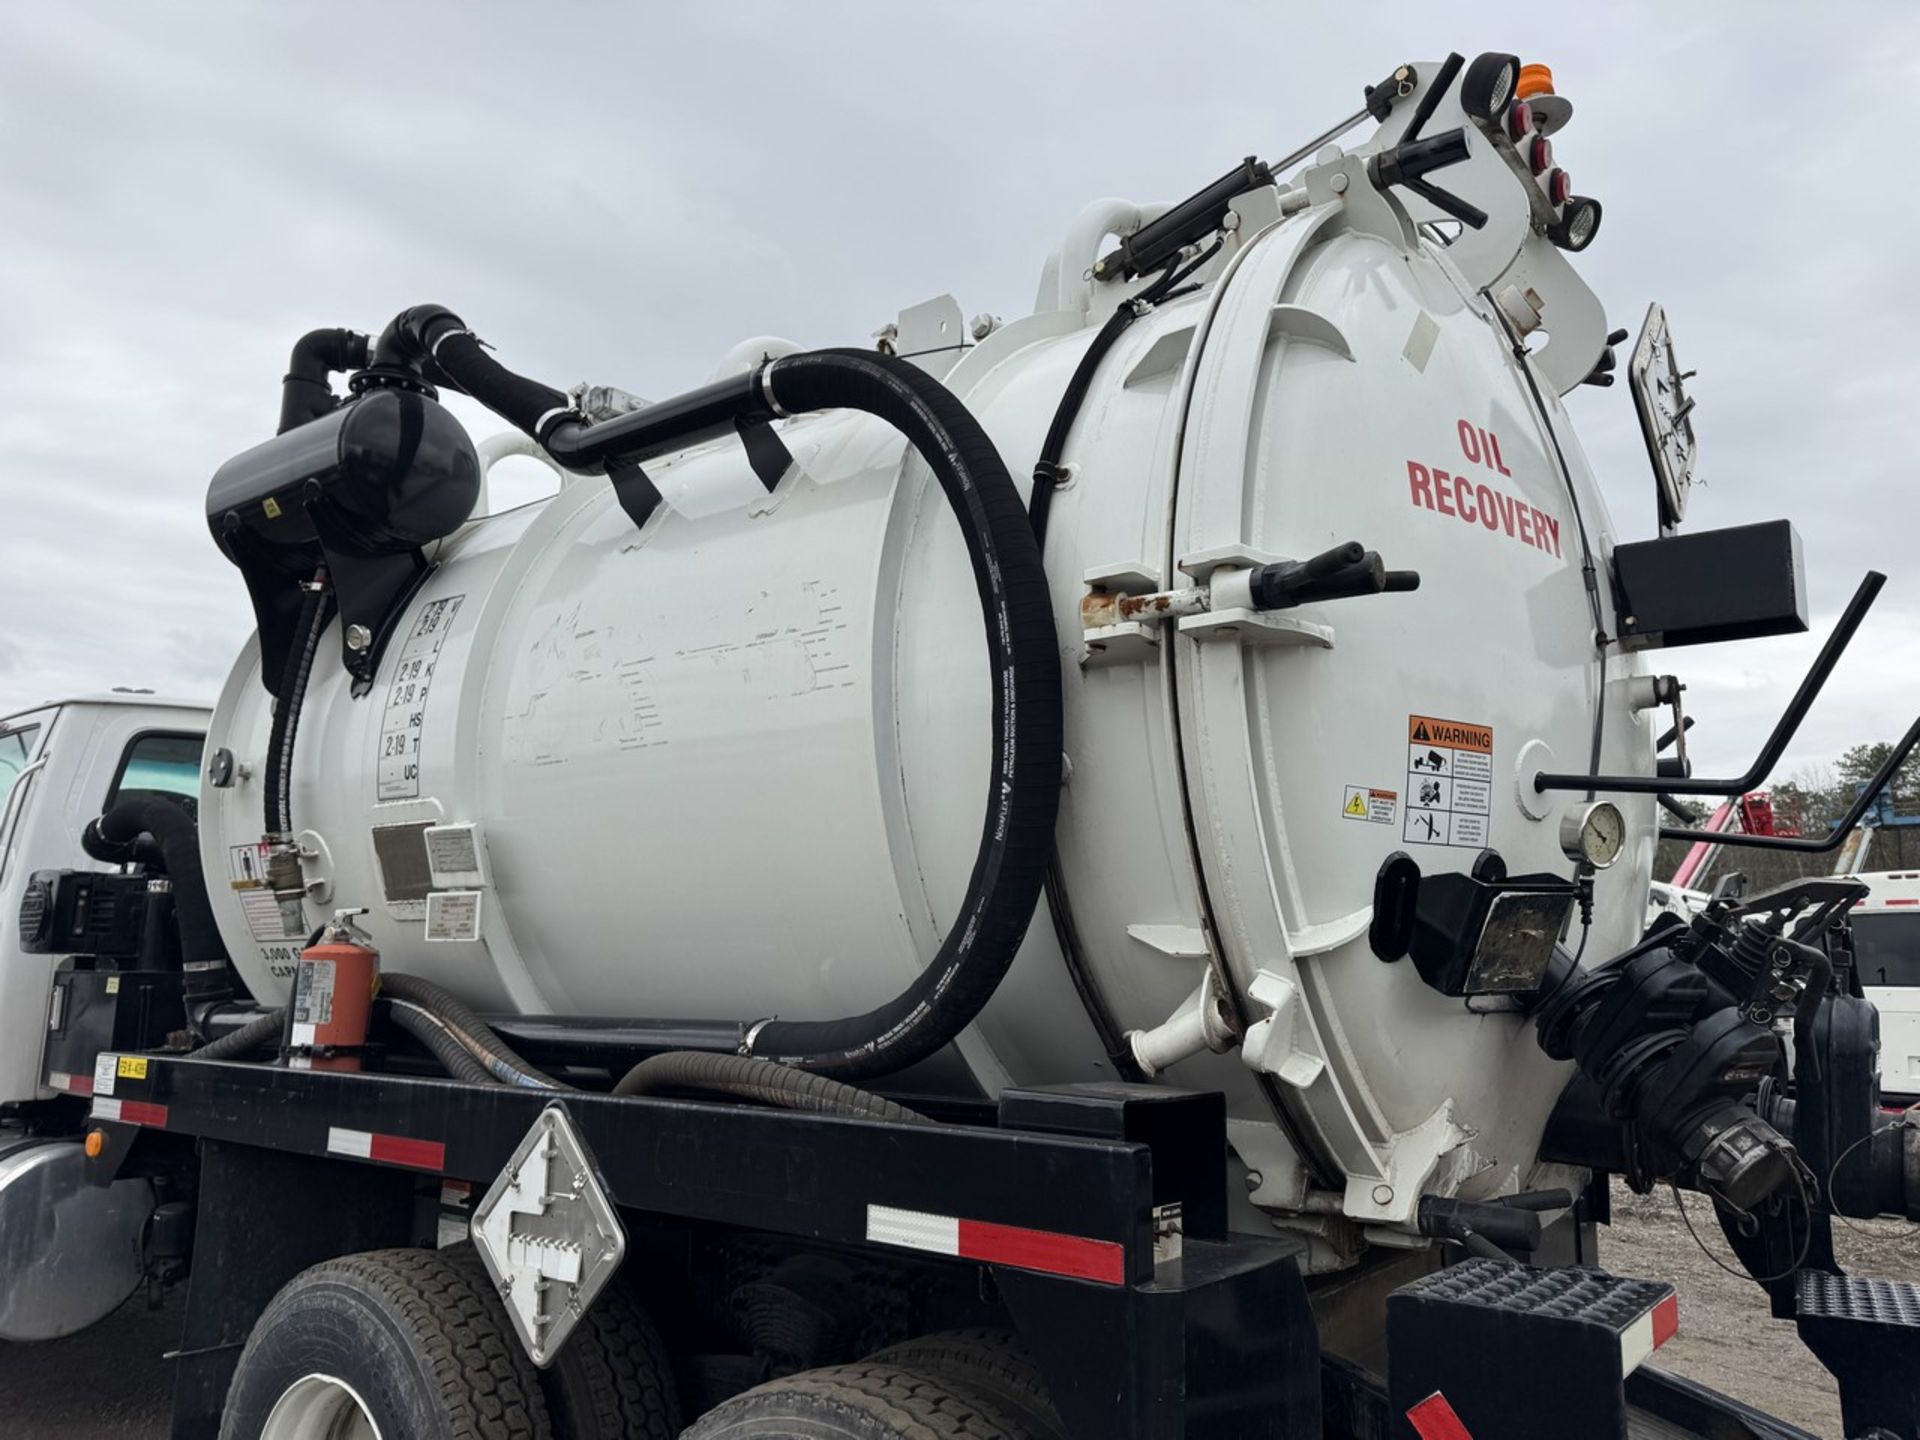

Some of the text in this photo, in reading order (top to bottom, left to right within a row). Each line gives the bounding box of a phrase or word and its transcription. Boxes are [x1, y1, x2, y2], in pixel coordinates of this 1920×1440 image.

[1457, 419, 1511, 477] OIL
[1407, 460, 1561, 559] RECOVERY
[420, 686, 428, 702] P
[409, 712, 422, 728] HS
[1432, 725, 1490, 748] WARNING
[413, 738, 420, 753] T
[404, 764, 418, 780] UC
